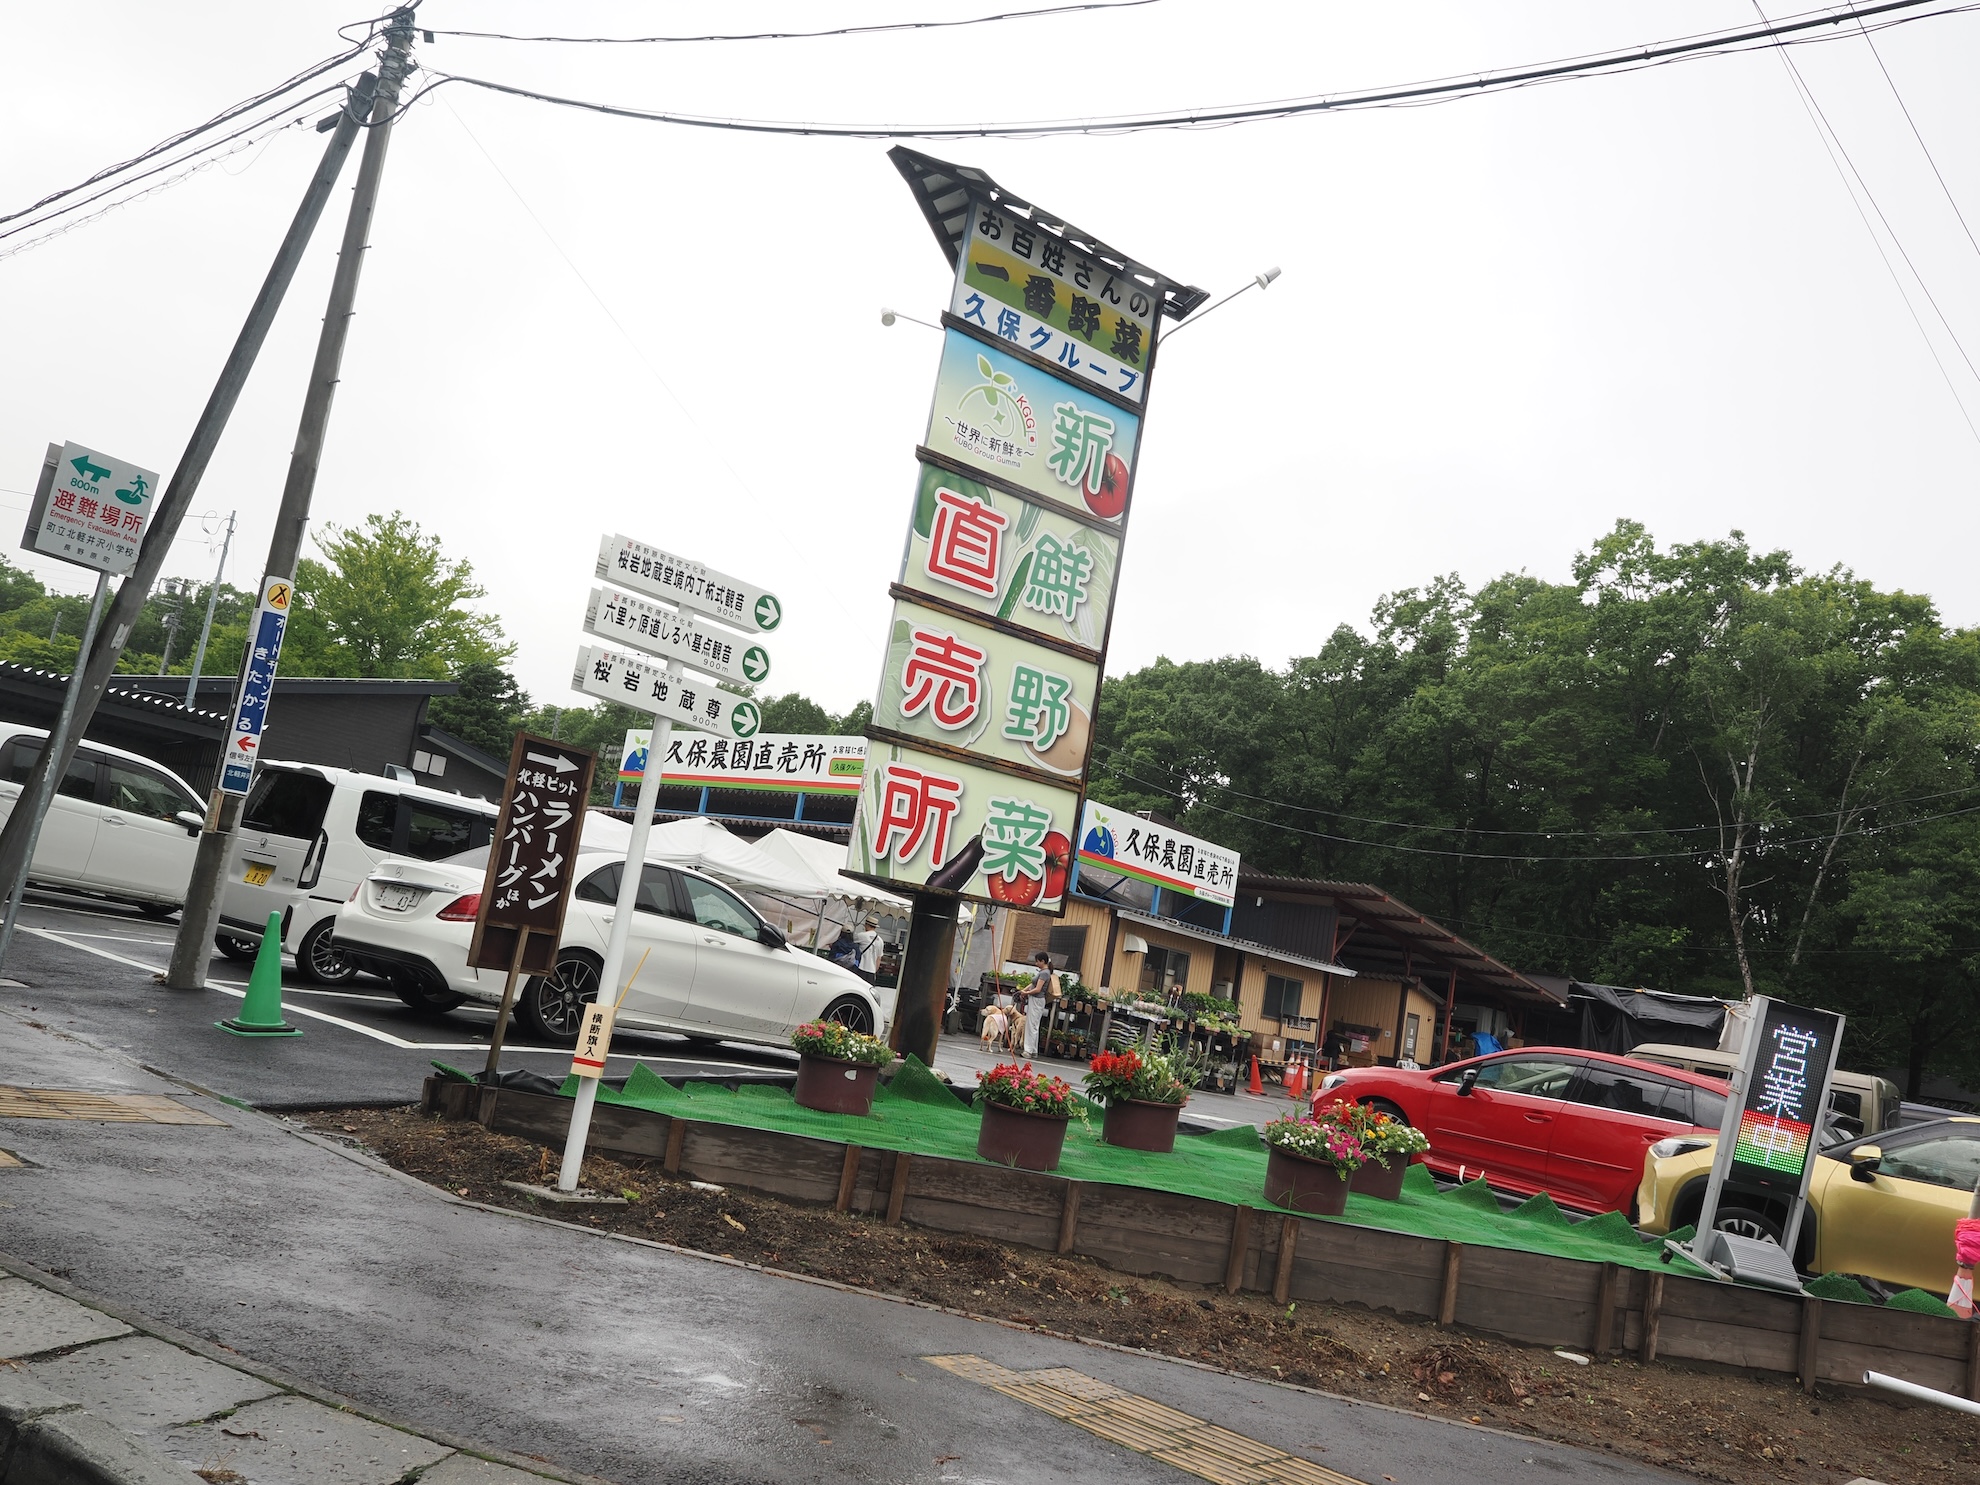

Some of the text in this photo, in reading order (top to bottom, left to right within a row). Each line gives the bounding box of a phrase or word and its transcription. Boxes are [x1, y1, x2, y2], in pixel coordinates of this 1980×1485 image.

[979, 209, 1150, 318] お百姓さんの
[976, 261, 1143, 365] 一番野菜
[964, 293, 1139, 393] 久保グループ
[1016, 395, 1035, 429] KGG
[954, 434, 1020, 468] KUBO Group Gumma
[53, 489, 143, 534] 避難場所
[70, 478, 100, 495] 800m
[46, 521, 134, 559] 町立北軽井沢小学校
[50, 510, 138, 544] Emergency Evacuation Area
[63, 544, 111, 563] 長野原町
[982, 406, 1113, 877] 新鮮野菜
[238, 647, 268, 731] きたかる
[593, 659, 722, 720] 桜岩地蔵尊
[877, 492, 1005, 866] 直売所
[517, 768, 578, 796] 北軽ピット
[664, 739, 827, 775] 久保農園直売所
[834, 763, 864, 771] 久保グルー
[496, 790, 539, 910] ハンバーグ ほか
[528, 800, 573, 910] ラーメン
[1124, 828, 1233, 889] 久保農園直売所
[584, 1012, 604, 1057] 横断旗入
[1753, 1023, 1817, 1166] 営業中
